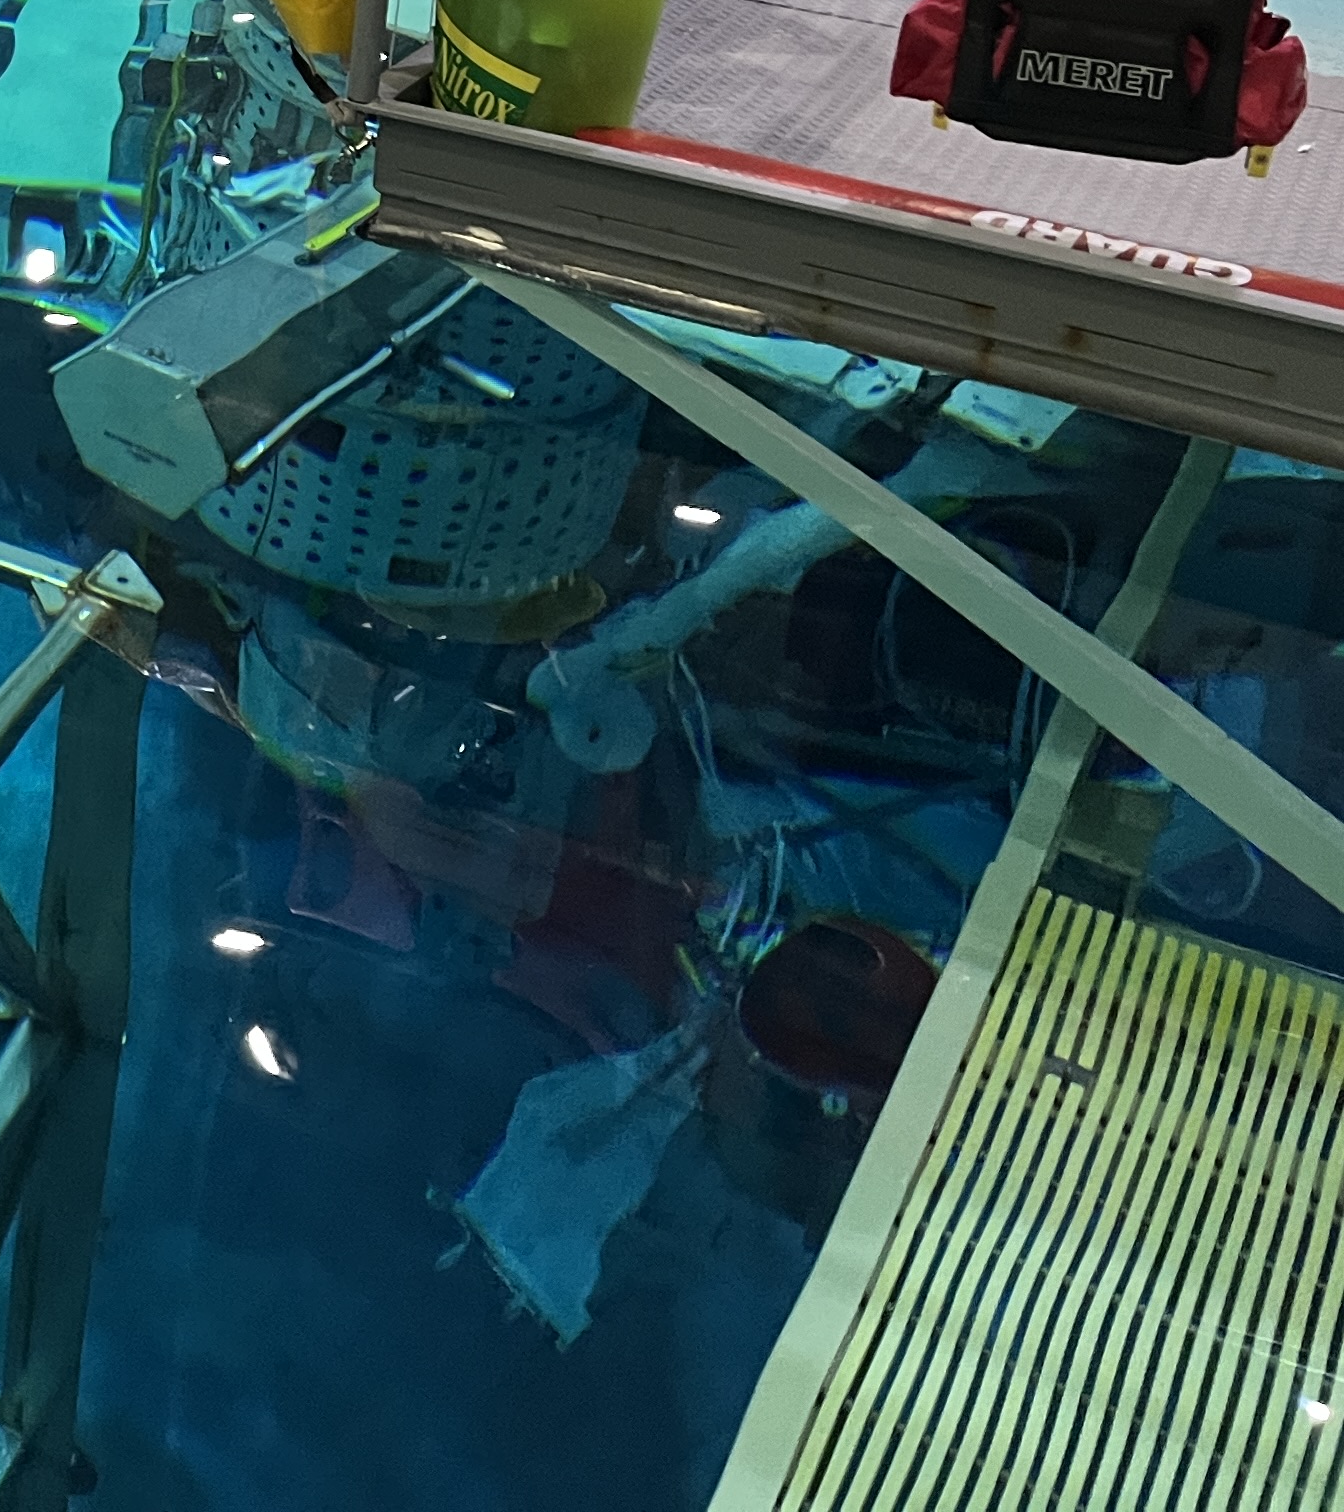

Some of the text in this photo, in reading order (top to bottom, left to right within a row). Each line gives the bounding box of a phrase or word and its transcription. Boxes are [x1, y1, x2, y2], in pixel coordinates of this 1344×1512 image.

[441, 36, 517, 124] Nitrox
[1016, 48, 1174, 101] MERET
[970, 210, 1253, 286] GUARD
